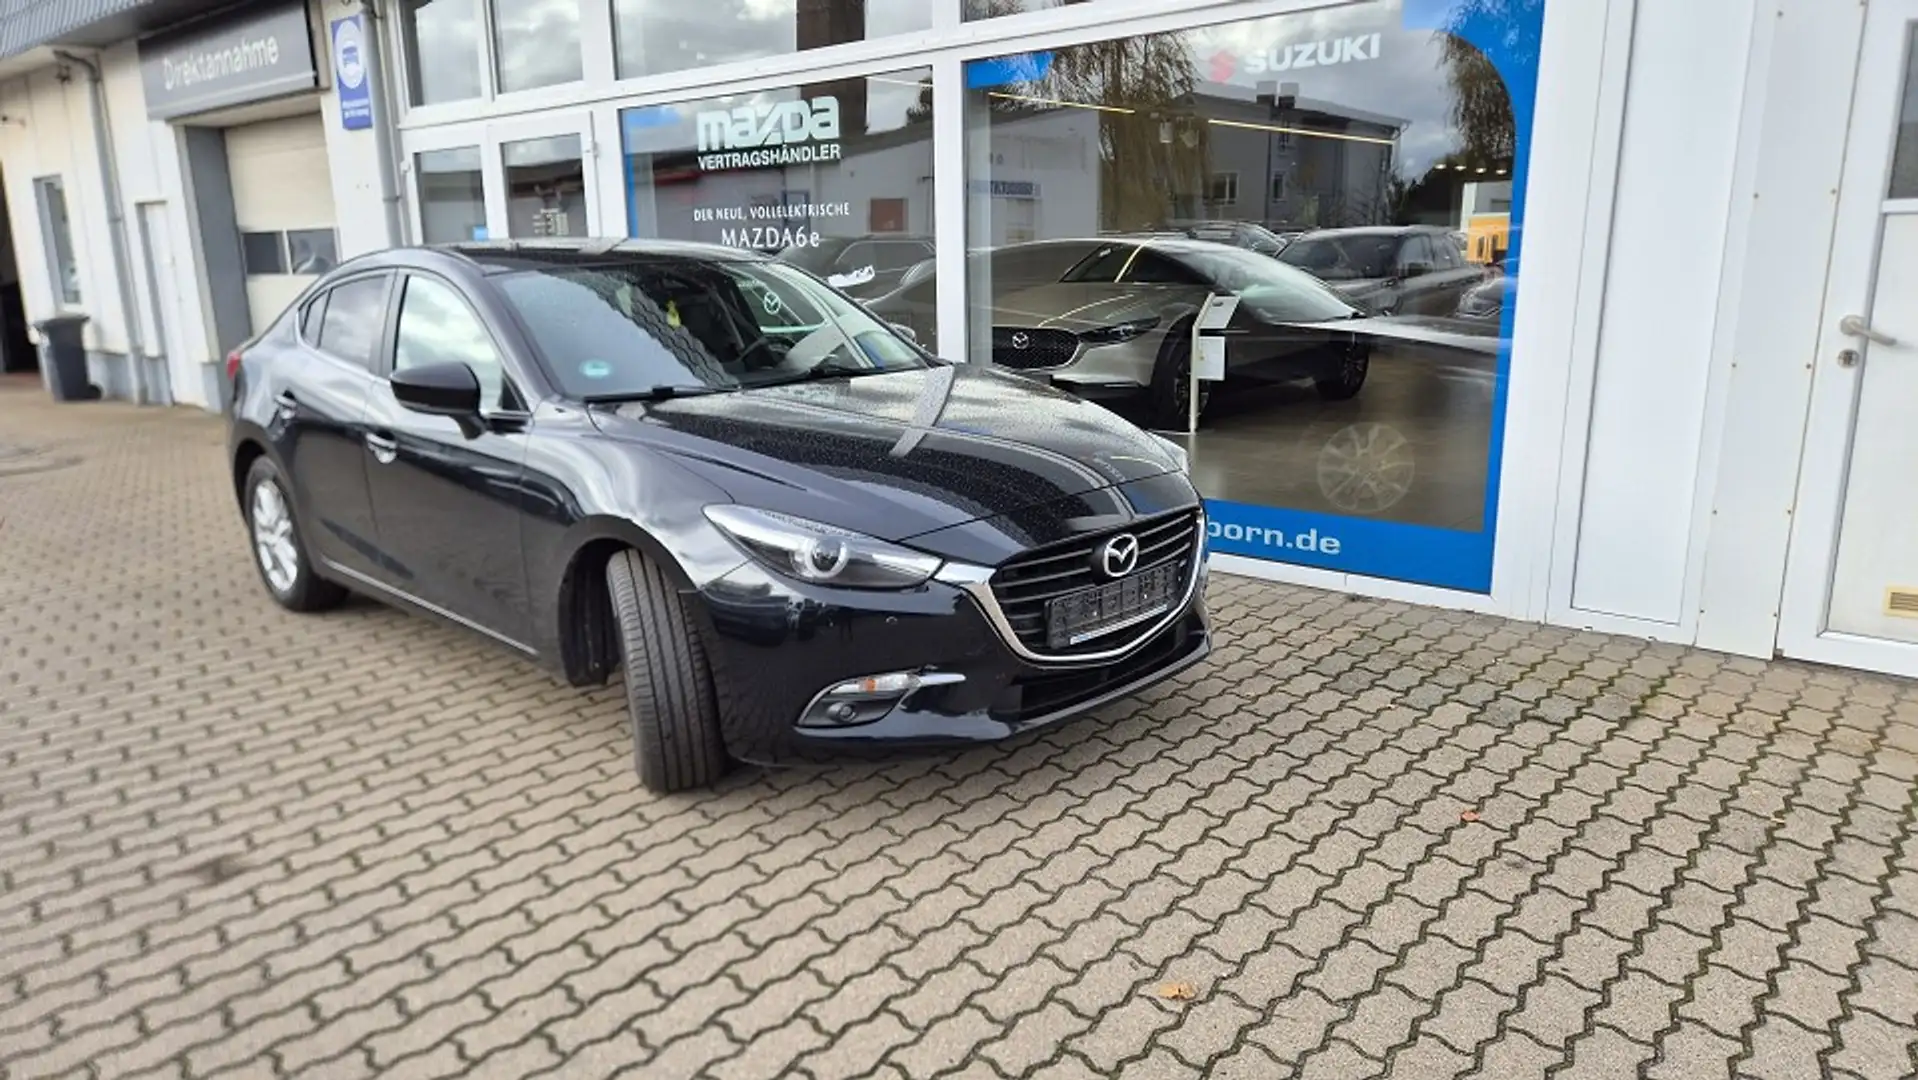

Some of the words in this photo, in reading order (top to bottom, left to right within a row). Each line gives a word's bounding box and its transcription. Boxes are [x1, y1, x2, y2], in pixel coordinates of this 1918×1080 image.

[163, 36, 279, 90] Direktannahme
[1244, 32, 1381, 74] SUZUKI
[698, 143, 841, 170] VERTRAGSHÄNDLER
[693, 208, 713, 221] DER
[750, 202, 850, 220] VOLLELEKTRISCHE
[721, 226, 820, 248] MAZDA6e
